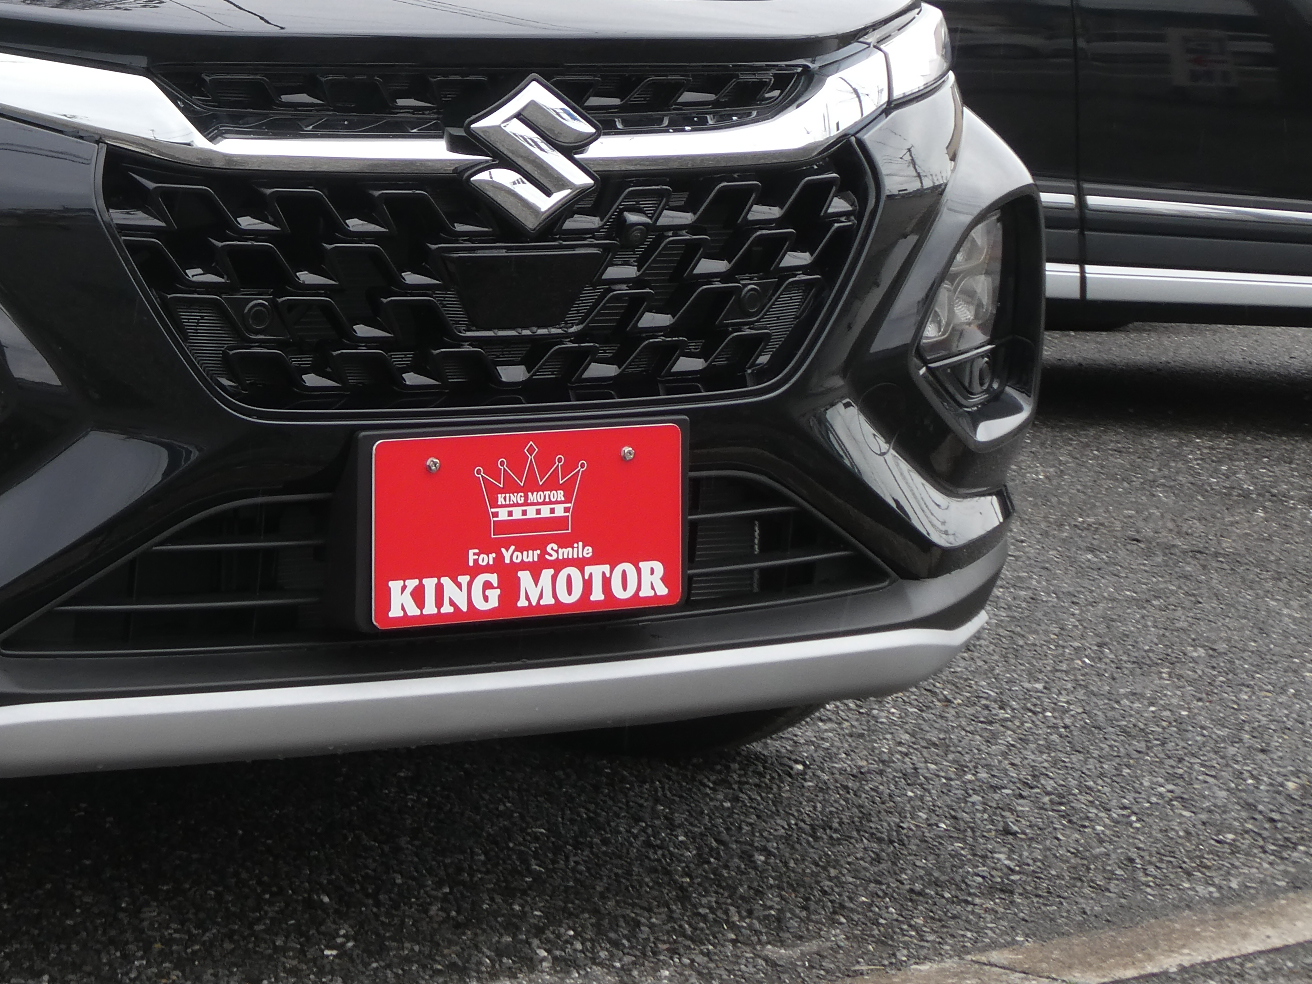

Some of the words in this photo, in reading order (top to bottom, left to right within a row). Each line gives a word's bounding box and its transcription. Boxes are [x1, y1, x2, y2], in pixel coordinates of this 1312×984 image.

[496, 491, 525, 506] KING
[527, 489, 565, 504] MOTOR
[468, 548, 497, 567] For
[501, 544, 541, 565] Your
[544, 541, 593, 562] Smile
[387, 572, 502, 618] KING
[516, 560, 669, 608] MOTOR
